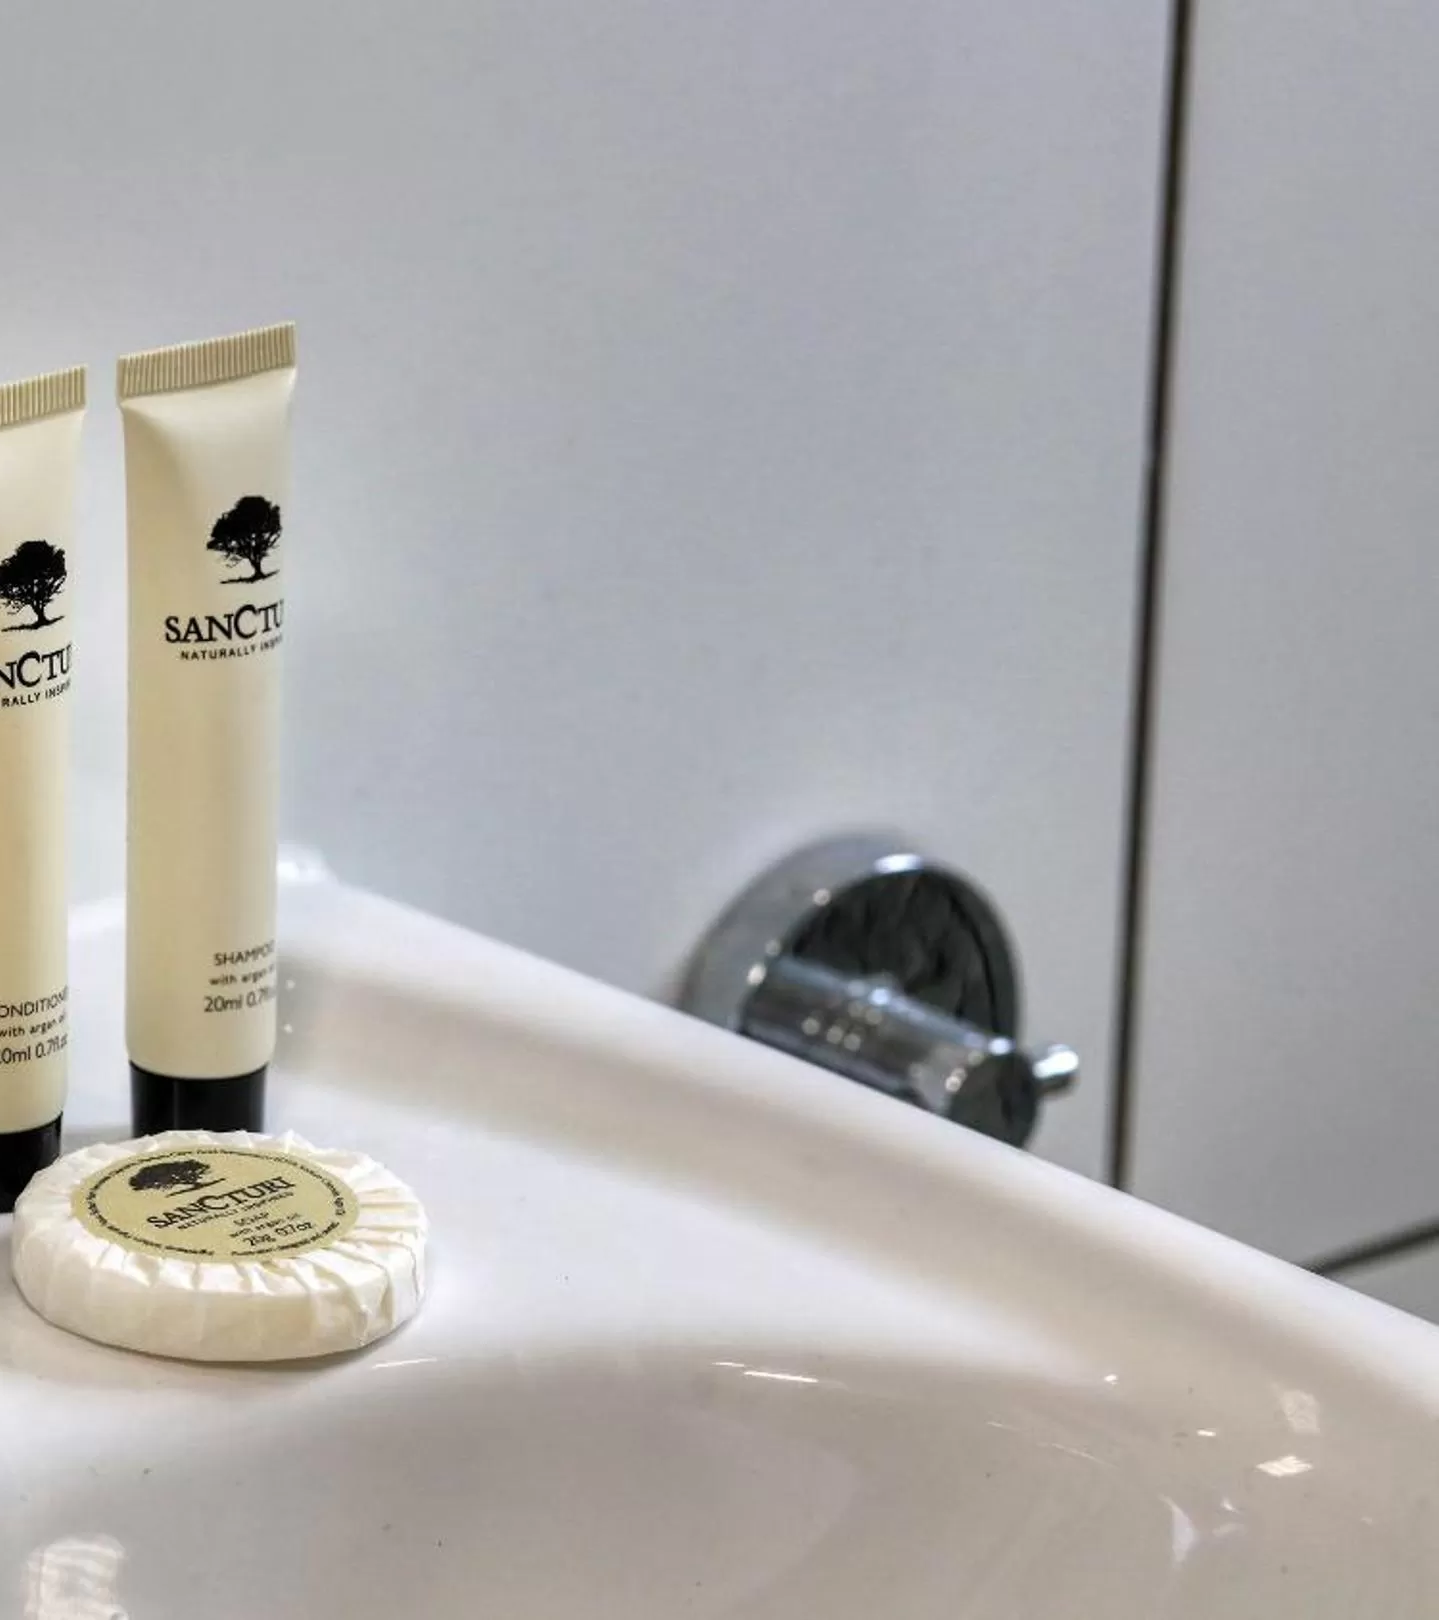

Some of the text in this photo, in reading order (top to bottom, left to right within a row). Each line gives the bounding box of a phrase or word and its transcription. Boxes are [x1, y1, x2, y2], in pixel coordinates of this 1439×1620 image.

[180, 644, 256, 661] NATURALLY
[203, 993, 242, 1013] 20ml
[146, 1175, 296, 1230] SANCTURI
